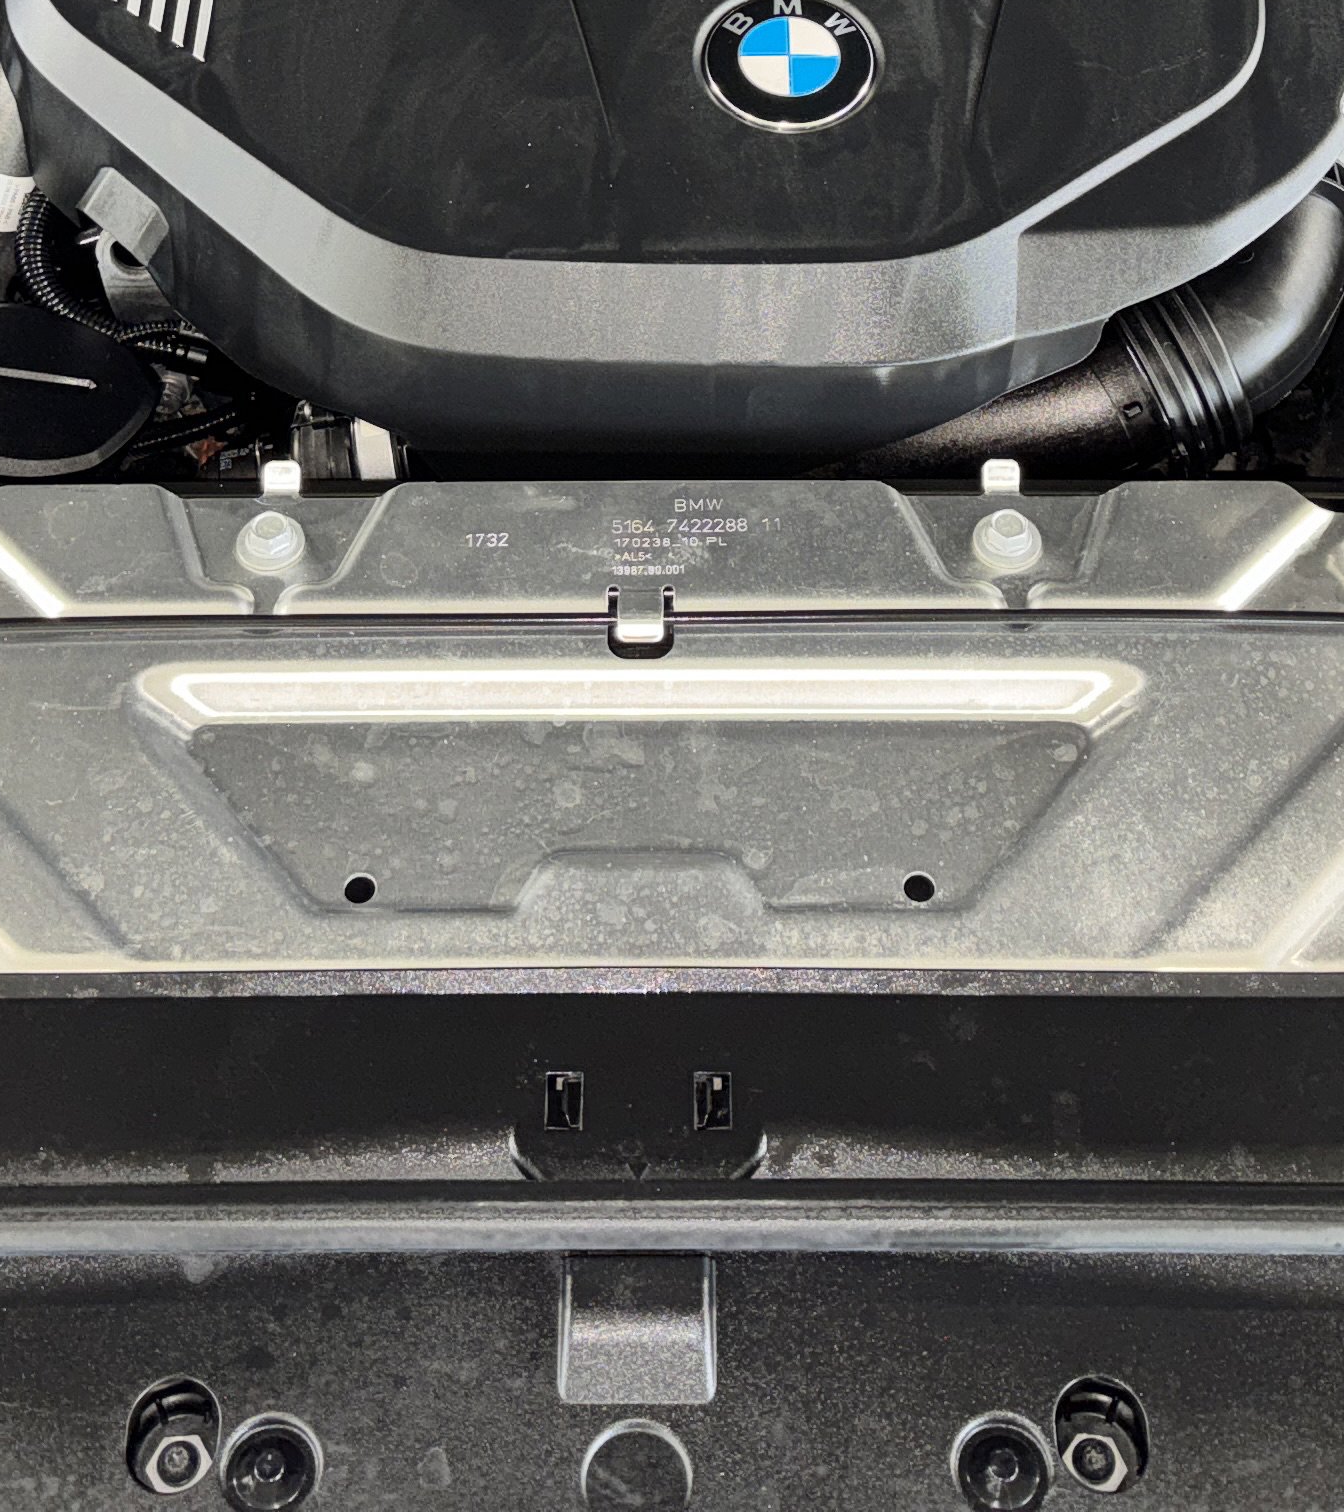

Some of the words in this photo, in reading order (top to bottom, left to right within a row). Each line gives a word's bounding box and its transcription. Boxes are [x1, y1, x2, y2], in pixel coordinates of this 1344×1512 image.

[674, 498, 724, 512] BMW
[611, 519, 655, 534] 5164
[667, 517, 748, 533] 7422288
[762, 517, 781, 531] 11
[465, 532, 510, 548] 1732
